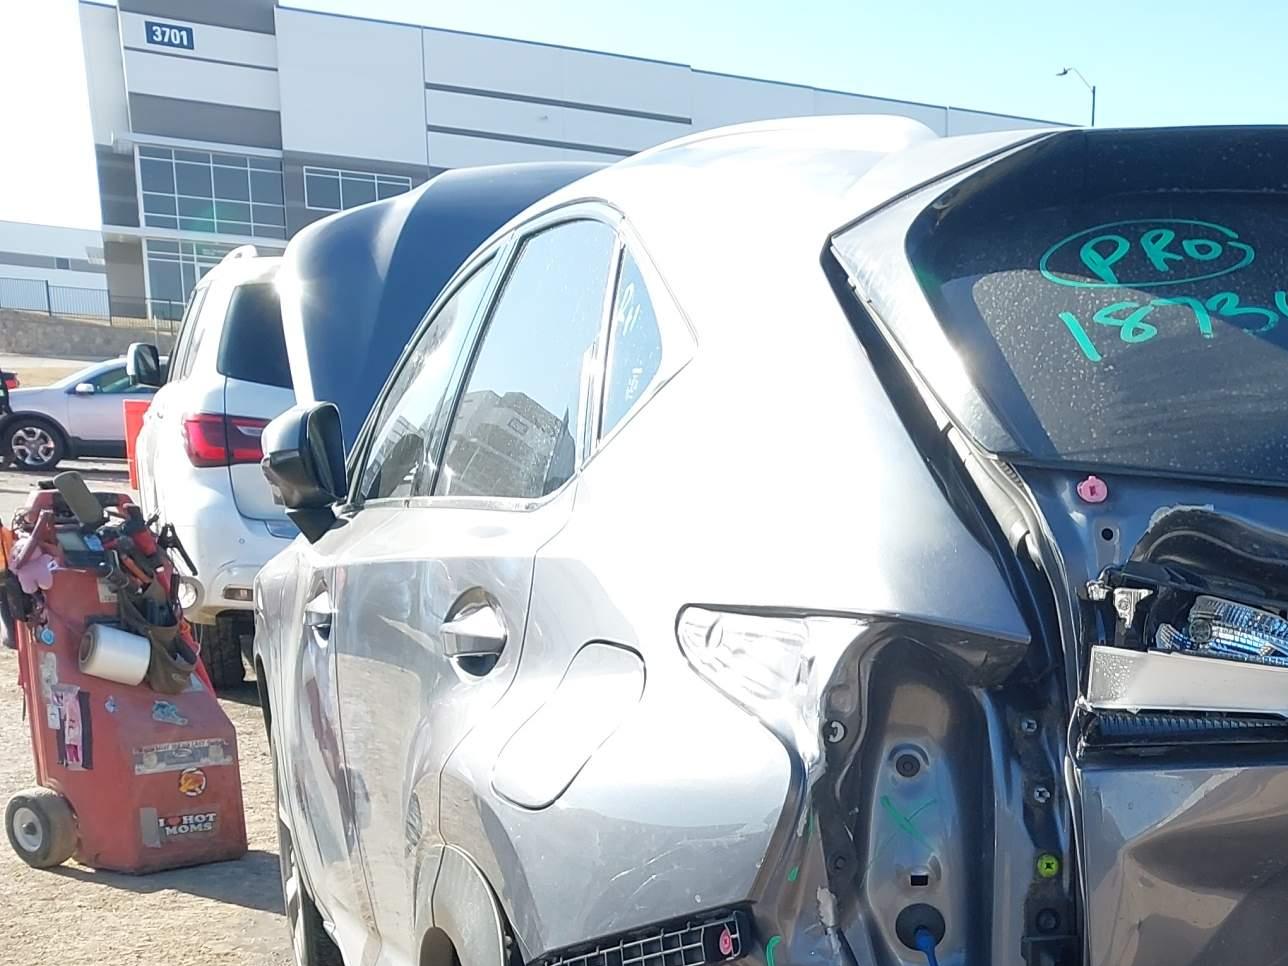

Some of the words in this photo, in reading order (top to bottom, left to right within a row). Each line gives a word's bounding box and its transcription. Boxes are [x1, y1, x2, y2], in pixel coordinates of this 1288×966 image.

[152, 25, 188, 47] 3701
[158, 817, 165, 828] I
[182, 812, 217, 825] HOT
[164, 822, 213, 836] MOMS
